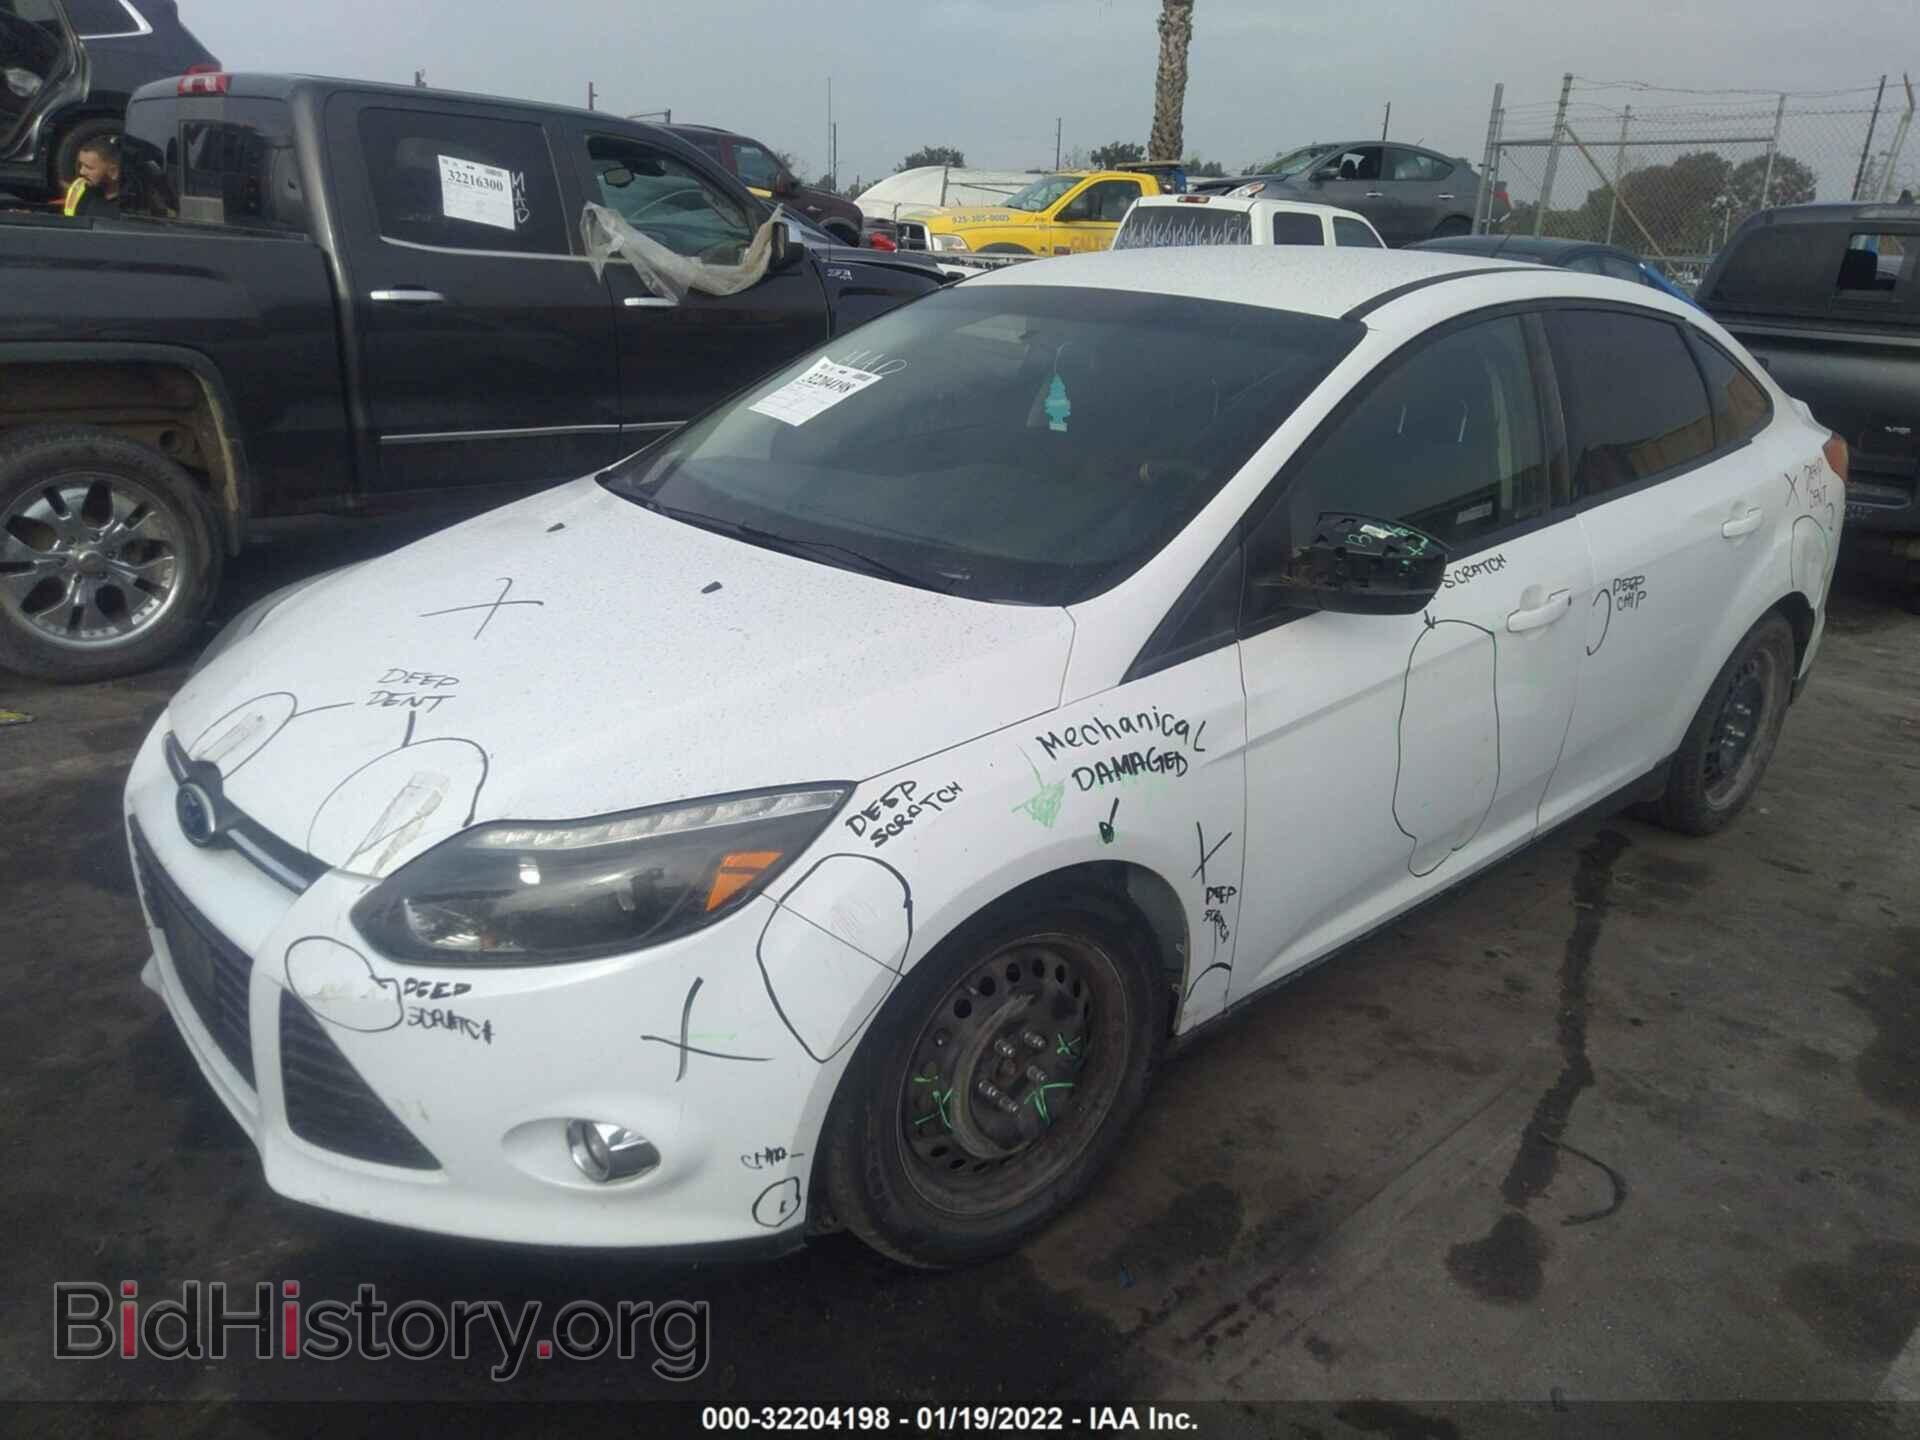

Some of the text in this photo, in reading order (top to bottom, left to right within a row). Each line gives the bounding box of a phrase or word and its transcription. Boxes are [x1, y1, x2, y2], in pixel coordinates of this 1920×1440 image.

[447, 169, 504, 192] 32216300
[1440, 553, 1507, 590] SCRATCH
[376, 667, 460, 689] DEEP
[365, 690, 457, 714] DENT
[1071, 746, 1188, 791] DAMAGED
[844, 780, 918, 837] DEEP
[869, 781, 963, 848] SCRATCH
